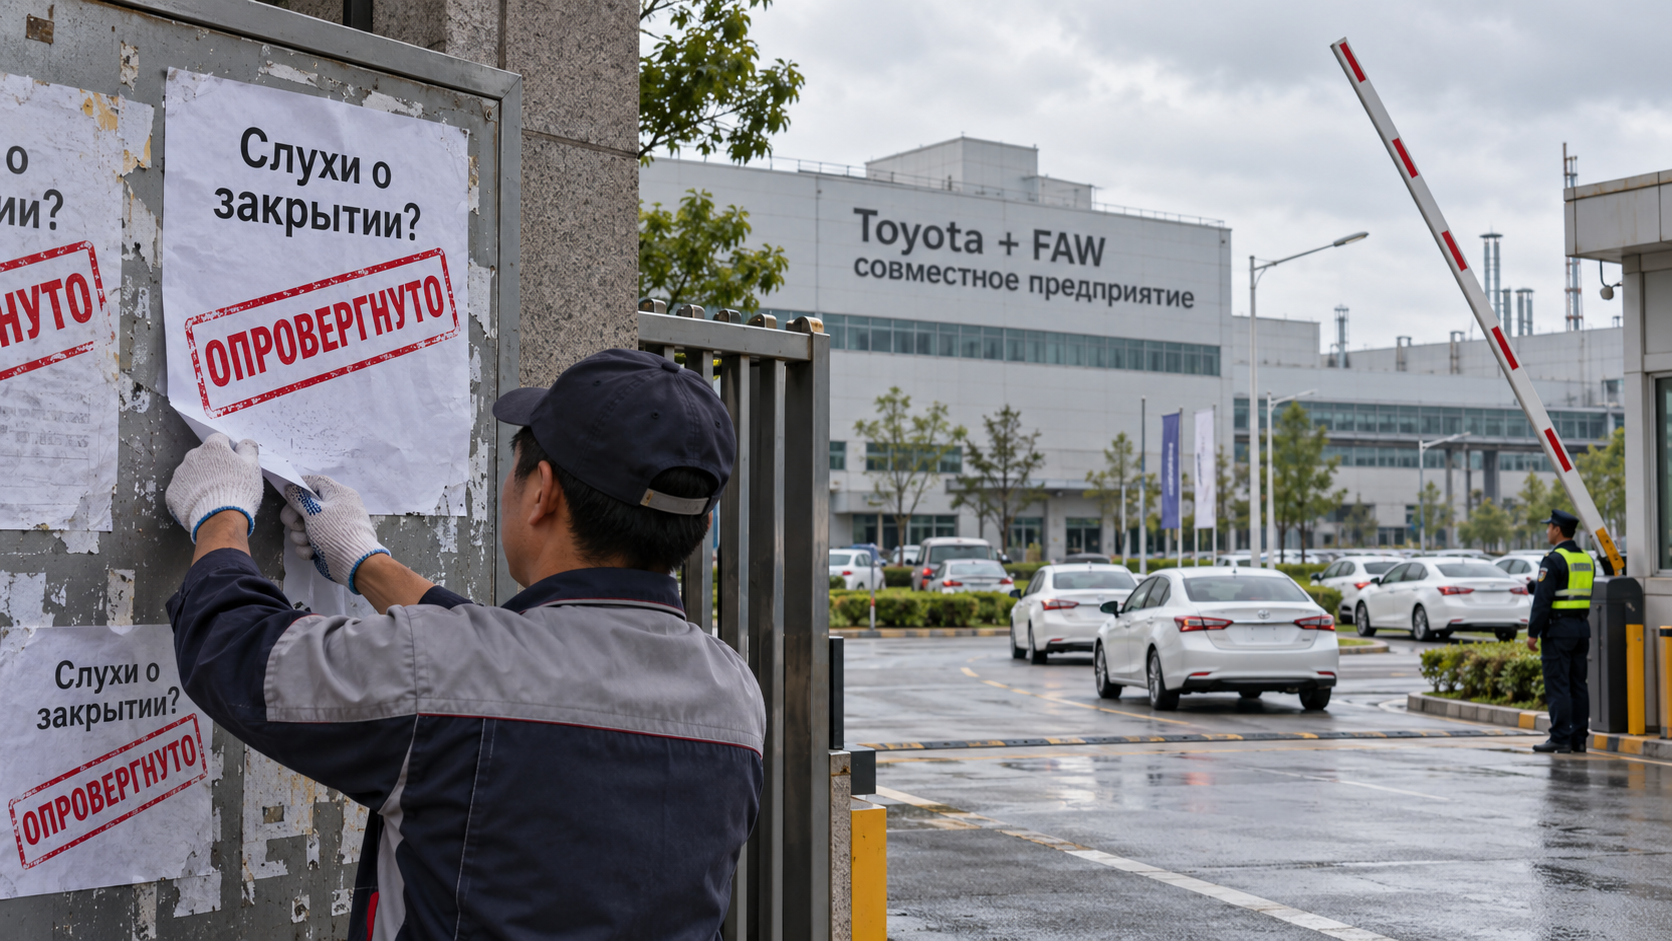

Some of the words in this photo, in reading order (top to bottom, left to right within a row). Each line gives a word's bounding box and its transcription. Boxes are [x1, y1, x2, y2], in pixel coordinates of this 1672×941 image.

[6, 145, 29, 175] о
[240, 126, 361, 186] Слухи
[372, 160, 392, 189] о
[213, 187, 421, 241] закрытии?
[853, 207, 984, 256] Toyota
[998, 231, 1020, 257] +
[1033, 228, 1106, 268] FAW
[853, 257, 1020, 292] совместное
[1029, 274, 1195, 309] предприятие
[205, 275, 445, 388] ОПРОВЕРГНУТО
[54, 659, 139, 694] Слухи
[145, 661, 161, 683] о
[36, 685, 181, 732] закрытии?
[22, 734, 197, 846] ОПРОВЕРГНУТО
